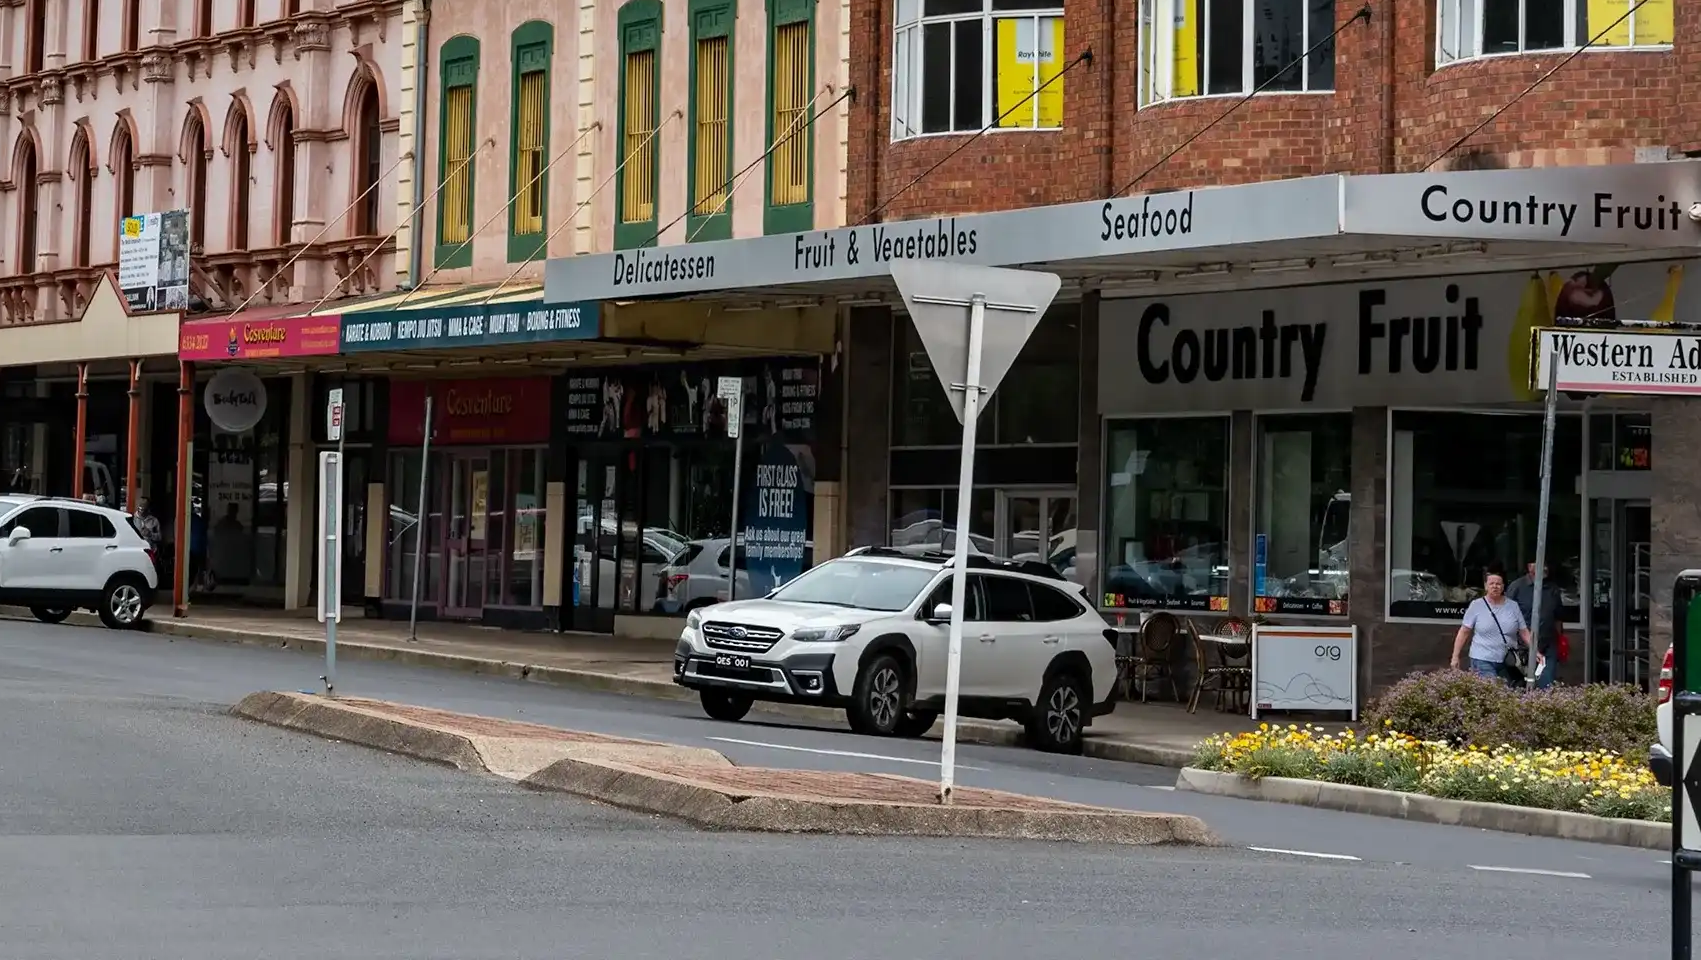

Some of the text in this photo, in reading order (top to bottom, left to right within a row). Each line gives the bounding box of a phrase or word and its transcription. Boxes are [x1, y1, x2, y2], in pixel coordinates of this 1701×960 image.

[1101, 192, 1193, 242] Seafood
[1421, 184, 1682, 237] Country Fruit
[614, 252, 715, 286] Delicatessen
[794, 232, 835, 270] Fruit
[847, 238, 860, 266] &
[527, 311, 548, 331] BOXING
[555, 308, 580, 329] FITNESS
[1137, 283, 1483, 402] Country Fruit
[1552, 334, 1654, 368] Western
[1612, 371, 1698, 384] ESTABLISHED
[756, 464, 798, 488] FIRST CLASS
[758, 489, 794, 518] IS FREE!
[744, 526, 806, 545] Ask us about our great
[745, 543, 804, 561] family memberships!
[1314, 645, 1341, 661] org
